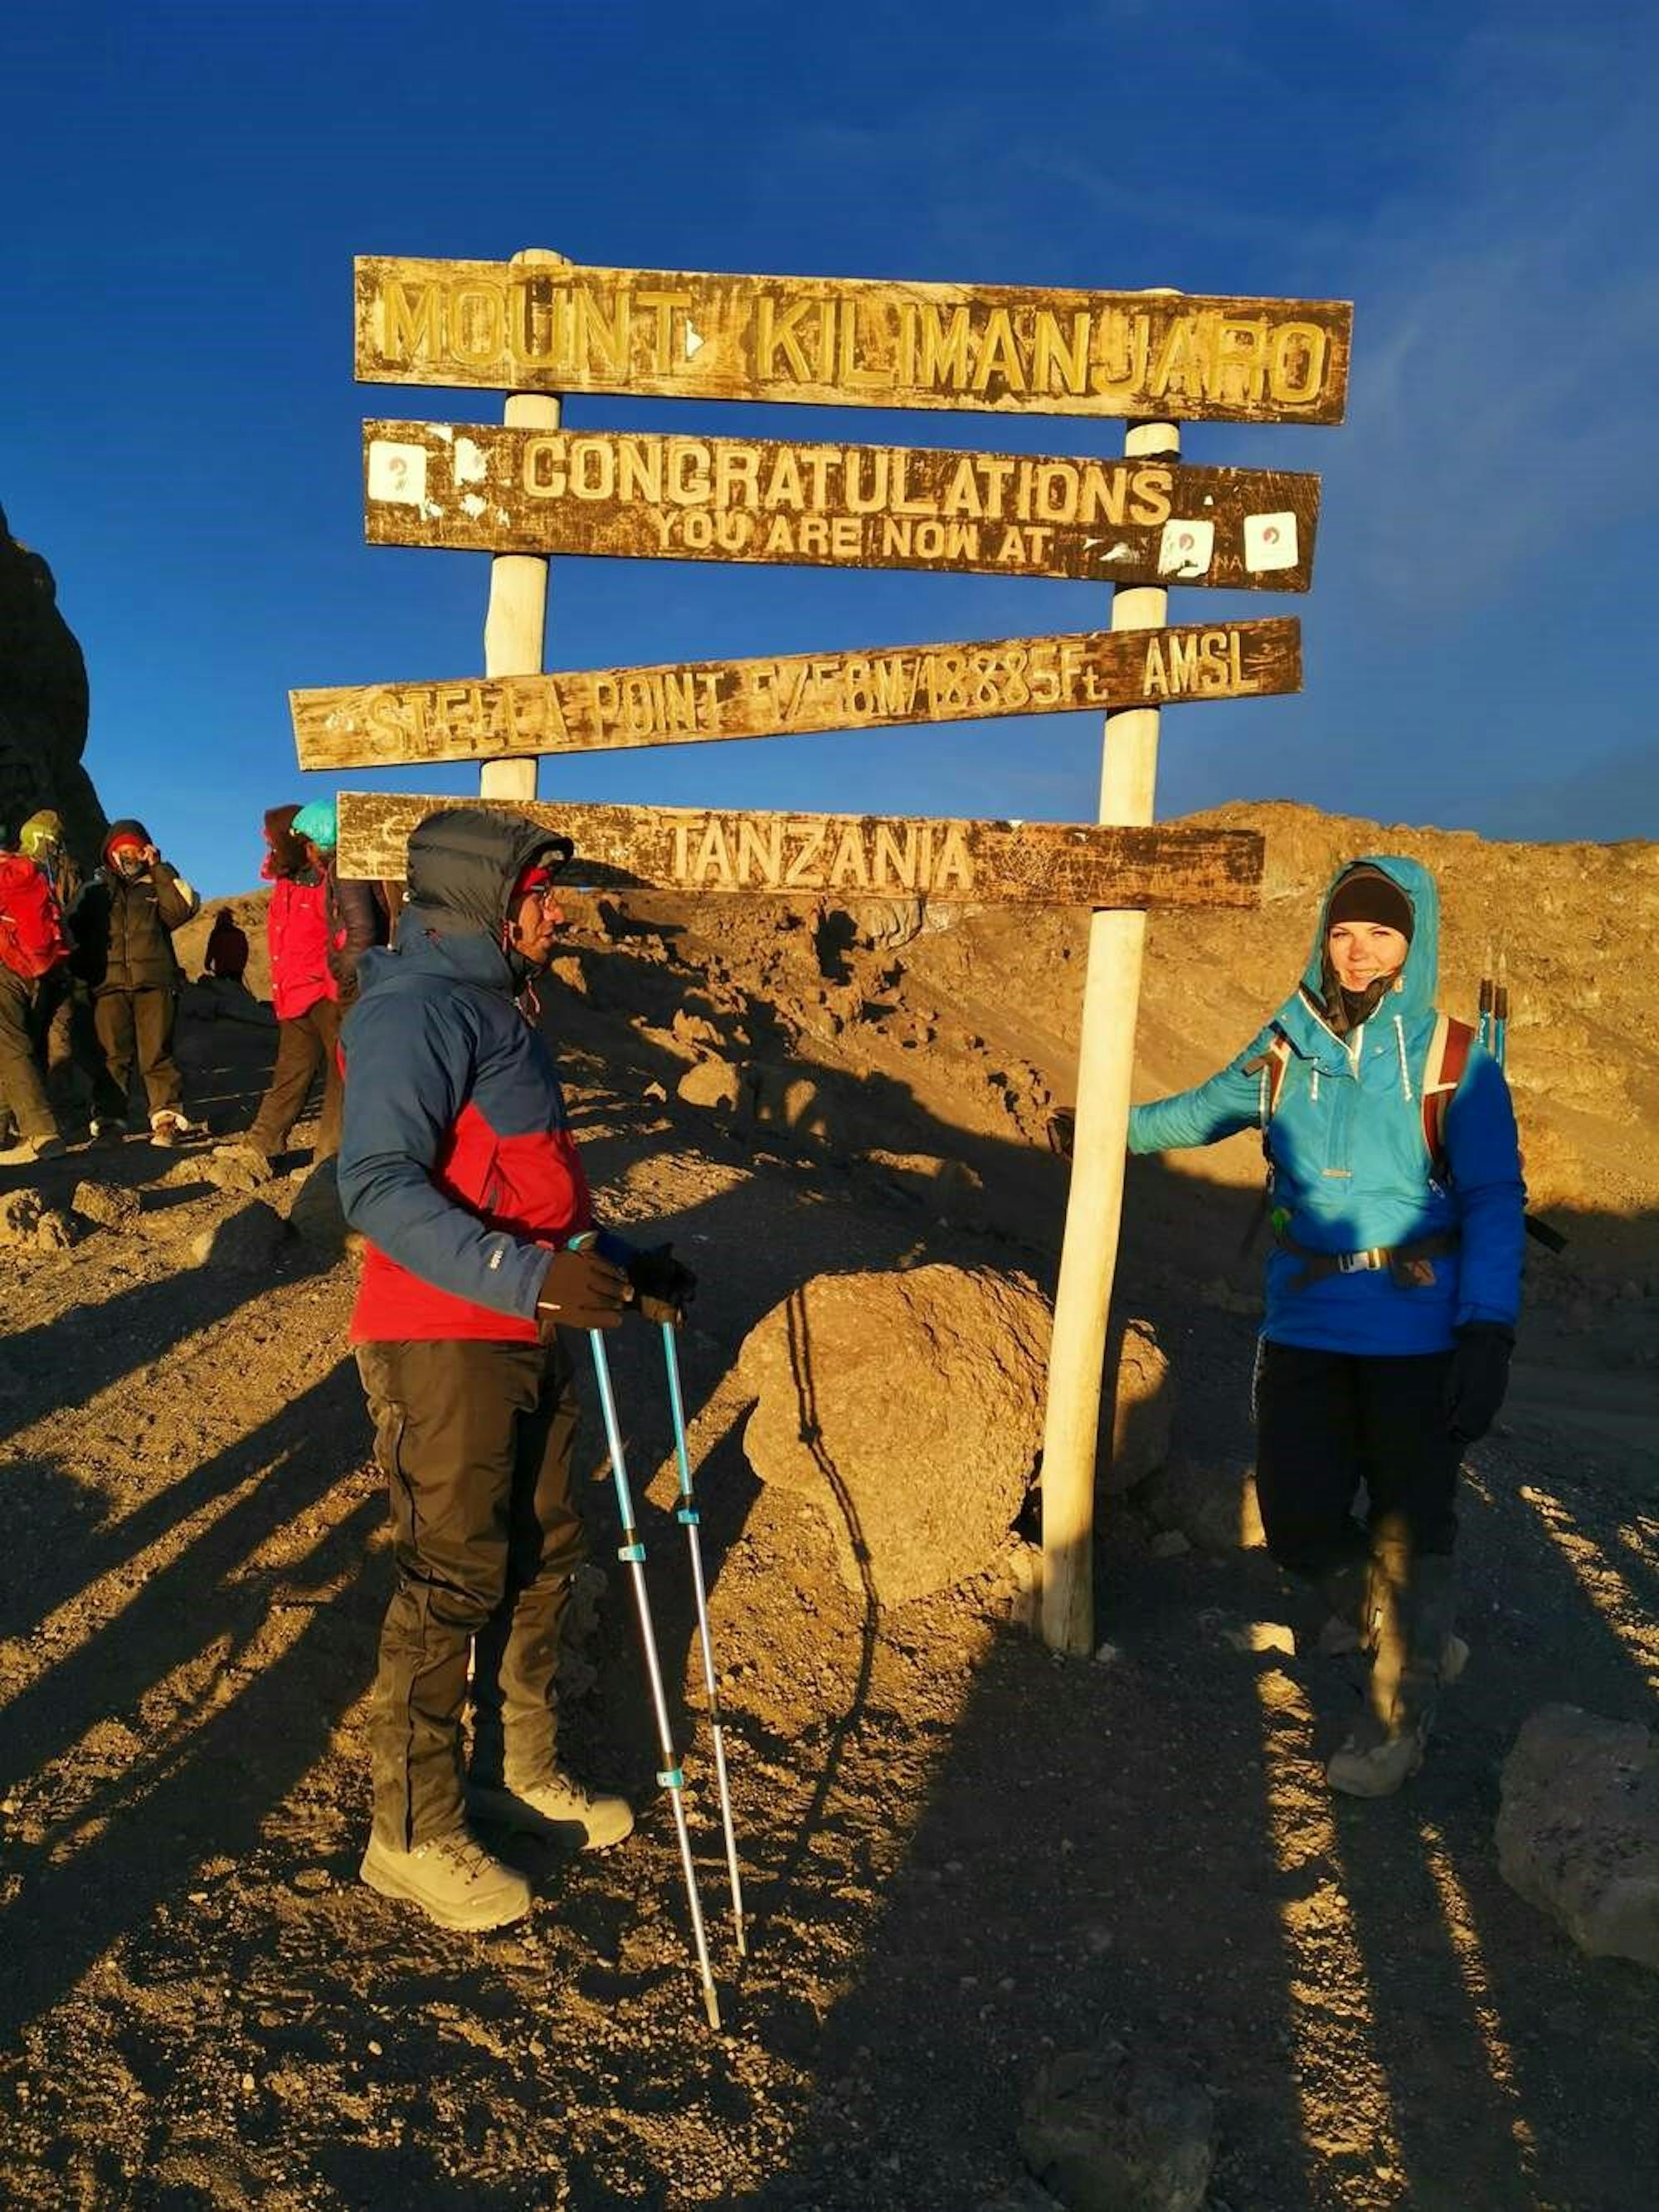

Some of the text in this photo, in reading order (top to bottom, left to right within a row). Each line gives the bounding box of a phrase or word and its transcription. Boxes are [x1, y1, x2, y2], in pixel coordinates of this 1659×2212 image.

[382, 280, 1328, 404] MOUNT KILIMANJARO
[523, 436, 1174, 528] CONGRATULATIONS
[654, 511, 1053, 565] YOU ARE NOW AT
[367, 677, 573, 755] STELLA
[594, 670, 725, 737] POINT
[1142, 631, 1260, 697] AMSL
[664, 816, 975, 893] TANZANIA
